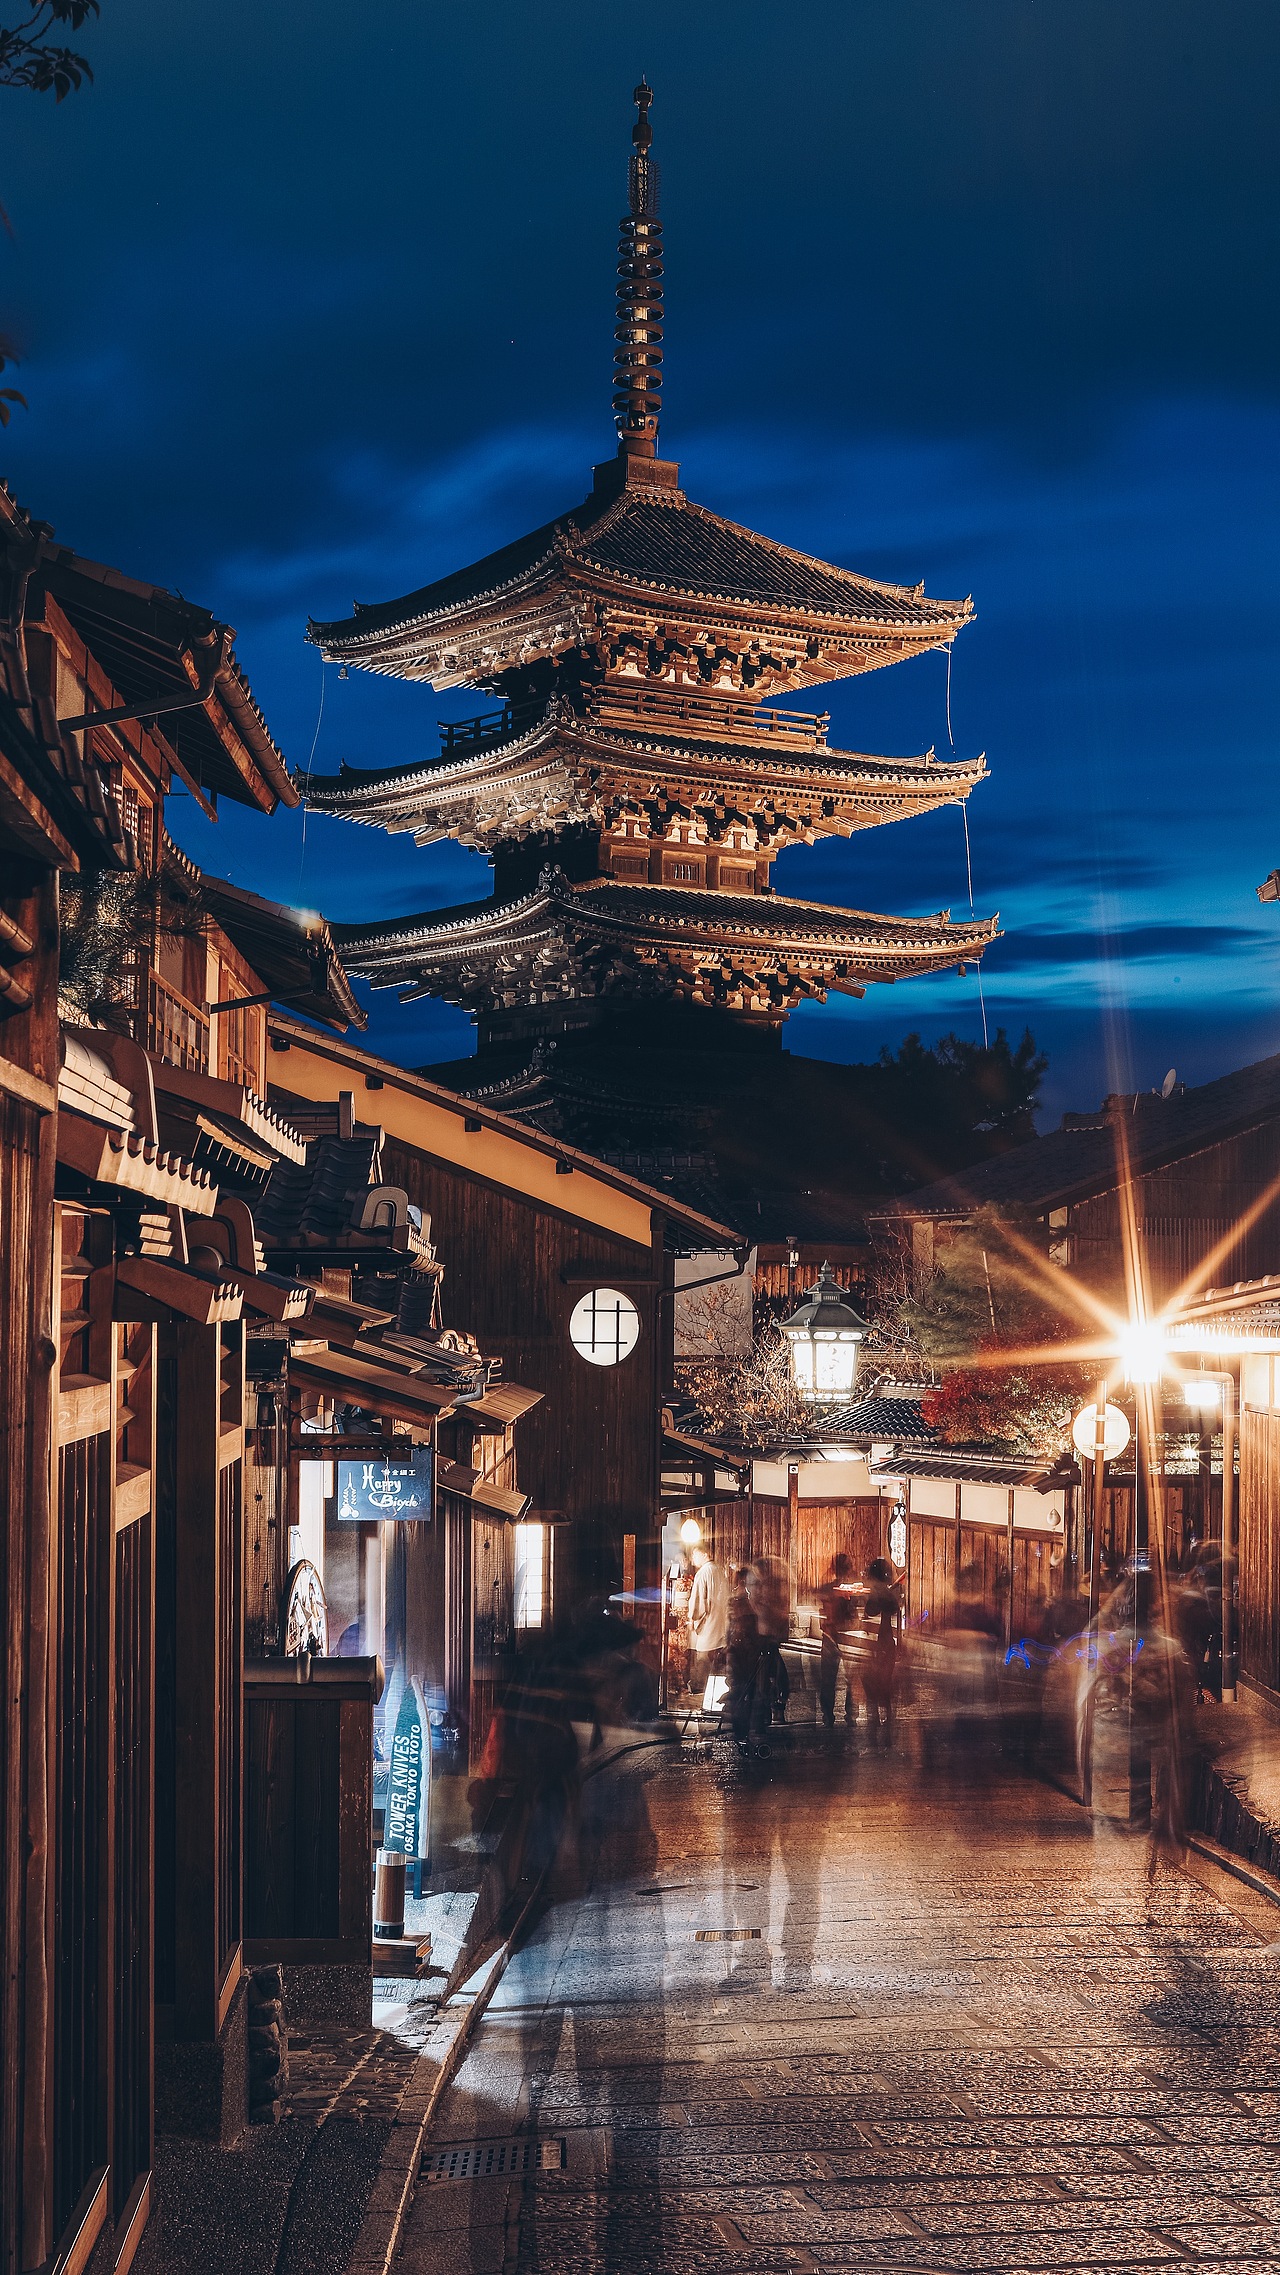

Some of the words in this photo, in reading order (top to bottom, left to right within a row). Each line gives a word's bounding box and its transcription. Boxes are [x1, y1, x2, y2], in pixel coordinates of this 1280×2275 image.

[362, 1464, 401, 1494] Happy
[379, 1493, 419, 1511] Bicycle
[391, 1735, 410, 1788] KNIVES
[410, 1724, 421, 1764] KYOTO
[407, 1769, 417, 1806] TOKYO
[389, 1793, 407, 1839] TOWER
[404, 1813, 416, 1852] OSAKA
